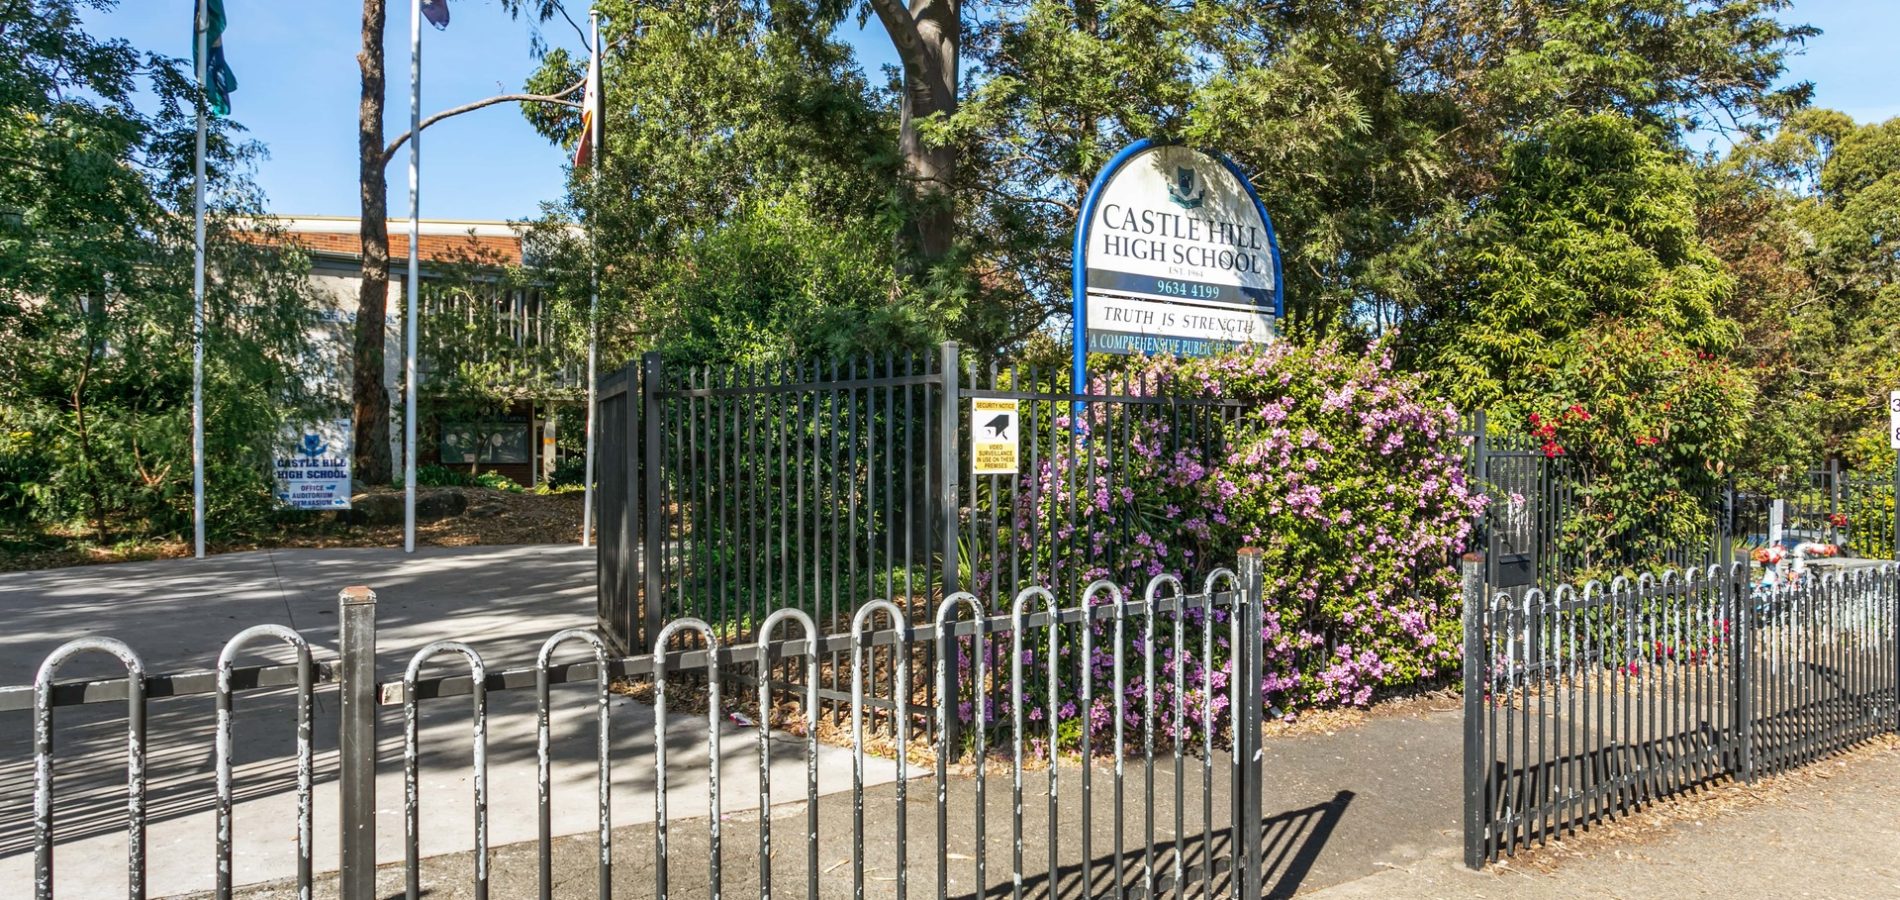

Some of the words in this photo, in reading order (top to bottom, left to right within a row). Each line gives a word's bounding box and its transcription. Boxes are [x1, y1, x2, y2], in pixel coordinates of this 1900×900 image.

[1103, 204, 1200, 241] CASTLE
[1208, 220, 1262, 250] HILL
[1104, 234, 1166, 262] HIGH
[1173, 244, 1261, 274] SCHOOL
[1158, 281, 1186, 295] 9634
[1191, 284, 1220, 299] 4199
[1104, 306, 1154, 325] TRUTH
[1162, 312, 1175, 327] IS
[1183, 315, 1256, 335] STRENGTH
[1089, 333, 1097, 348] A
[1100, 333, 1180, 354] COMPREHENSIVE
[277, 458, 319, 467] CASTLE
[322, 458, 347, 467] HILL
[277, 470, 303, 479] HIGH
[306, 470, 347, 479] SCHOOL
